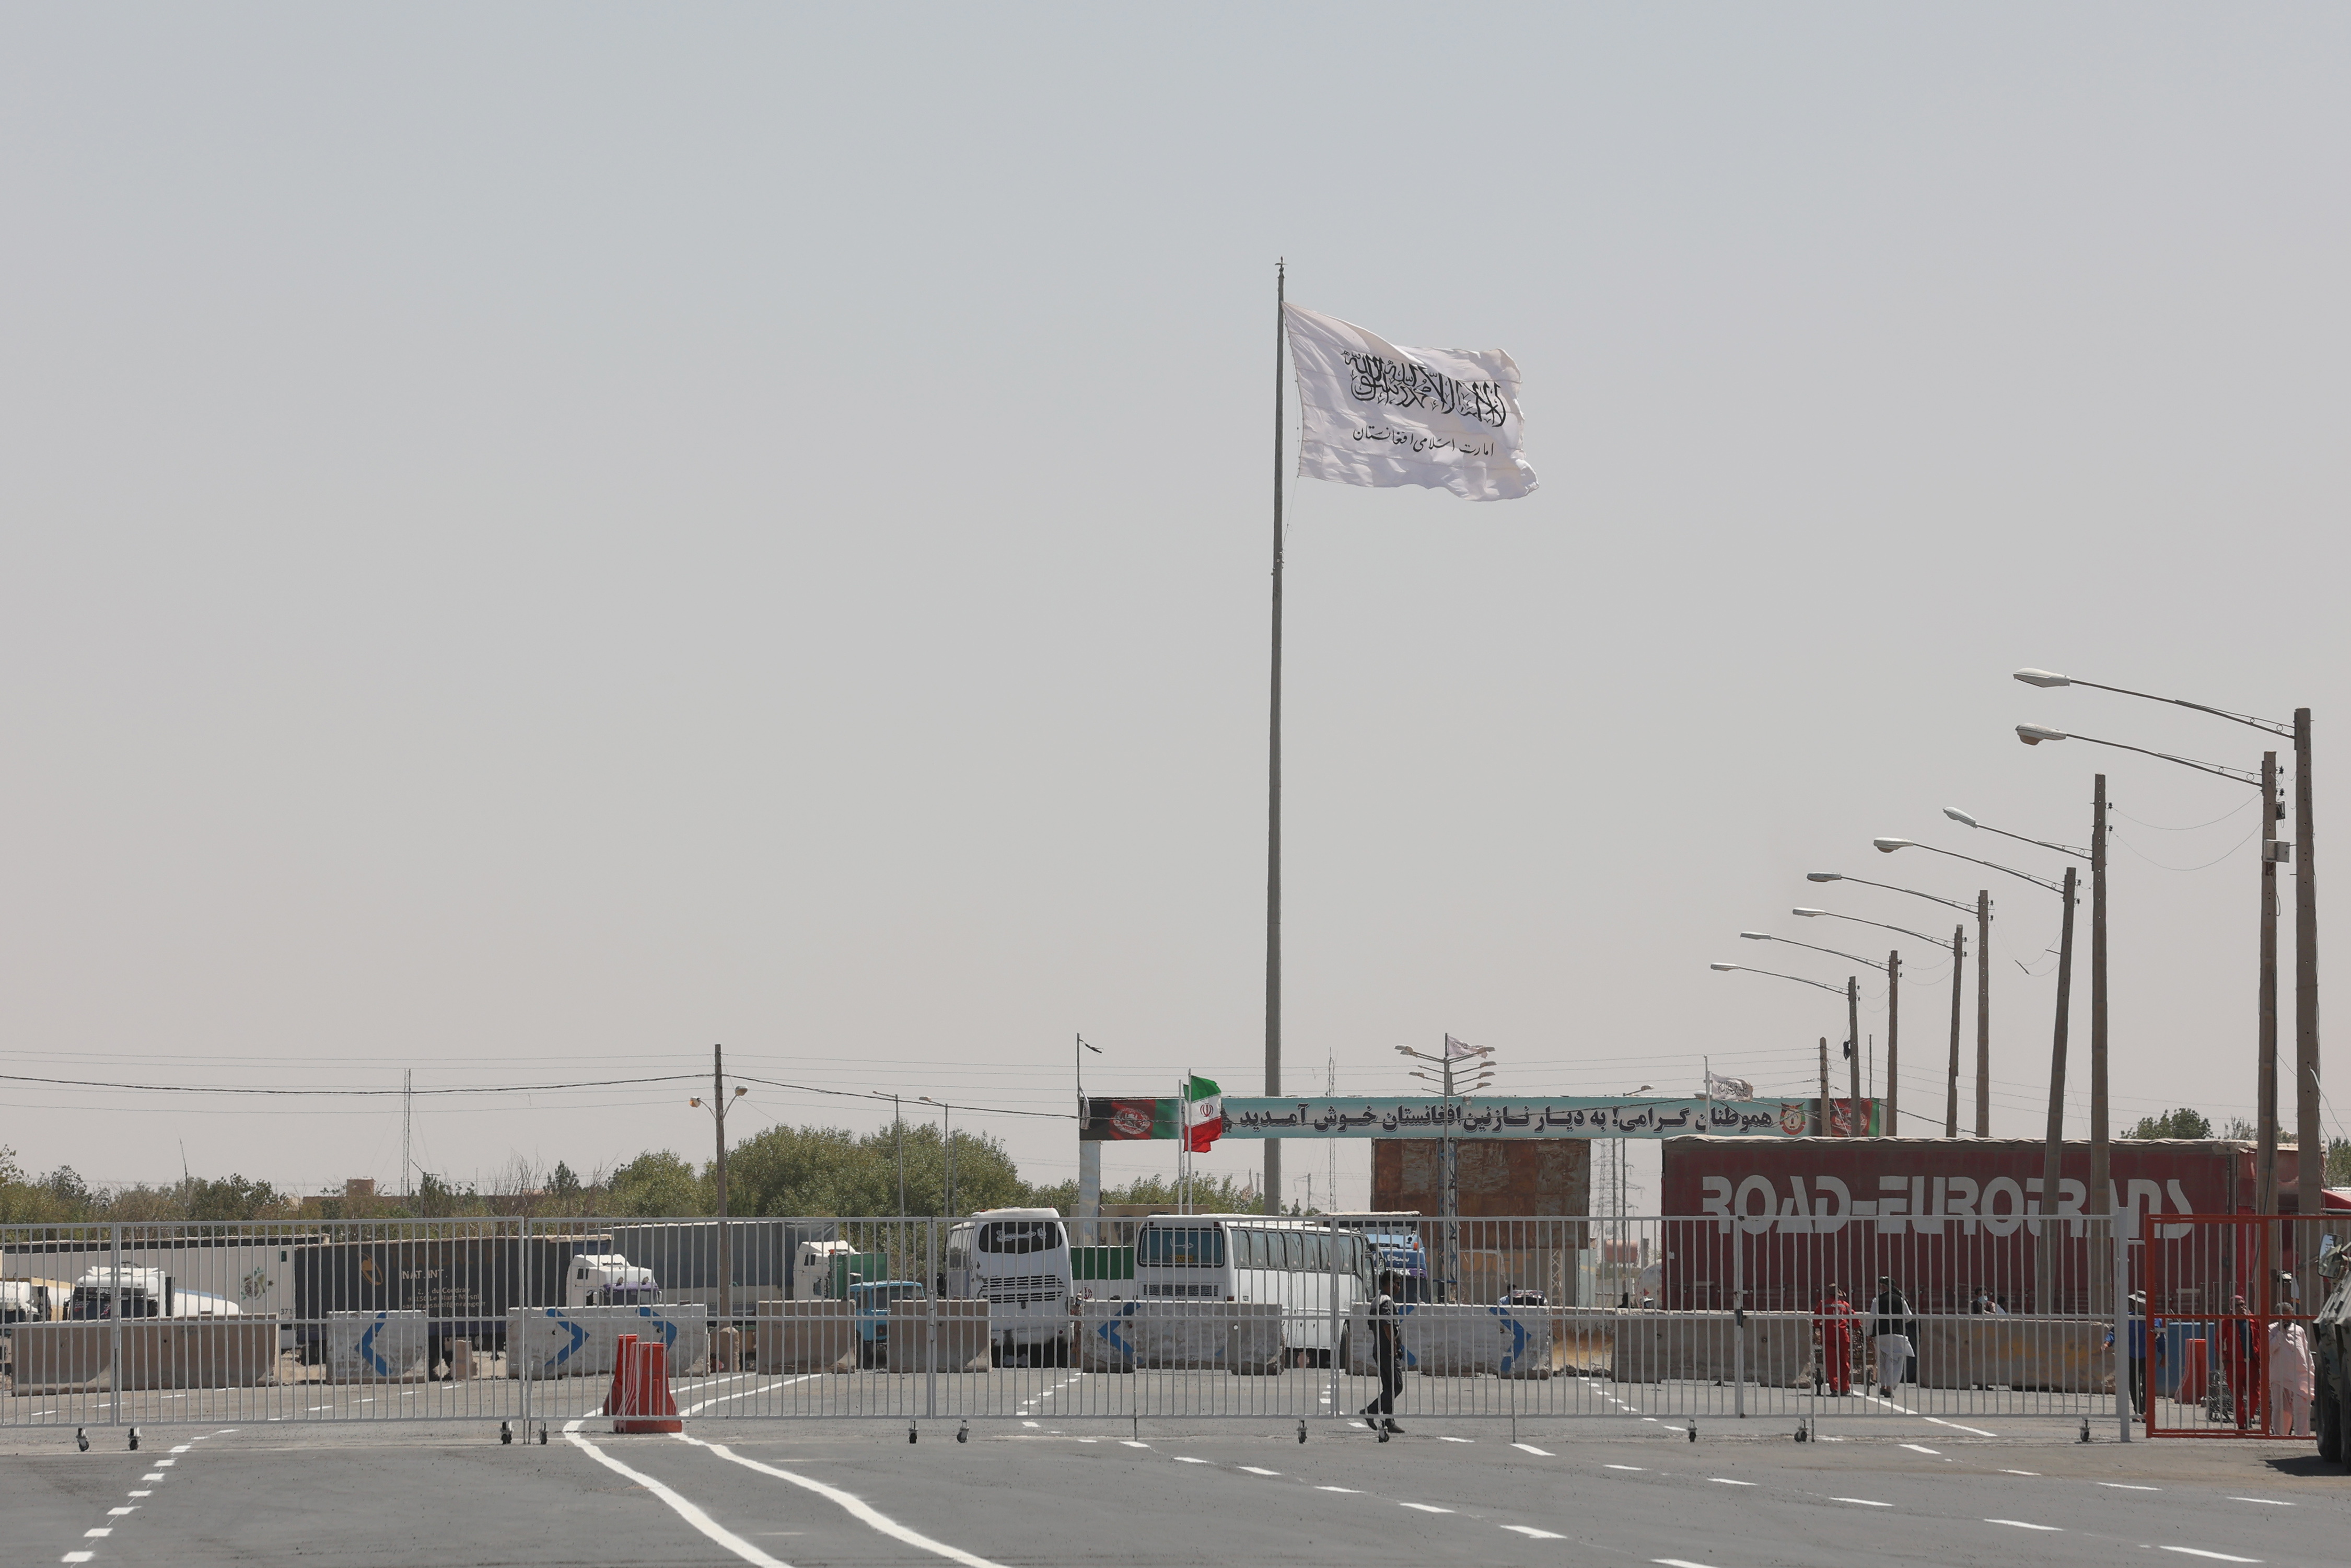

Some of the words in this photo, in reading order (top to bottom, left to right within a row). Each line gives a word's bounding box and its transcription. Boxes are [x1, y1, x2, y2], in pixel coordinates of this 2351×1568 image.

[1353, 425, 1414, 445] افغانستان
[1459, 442, 1494, 456] امارت
[1240, 1103, 1309, 1133] آمدید
[1314, 1105, 1378, 1133] خوش
[1382, 1103, 1462, 1132] افغانستان
[1463, 1105, 1530, 1133] نازنین
[1534, 1105, 1585, 1133] دیار
[1589, 1109, 1606, 1131] به
